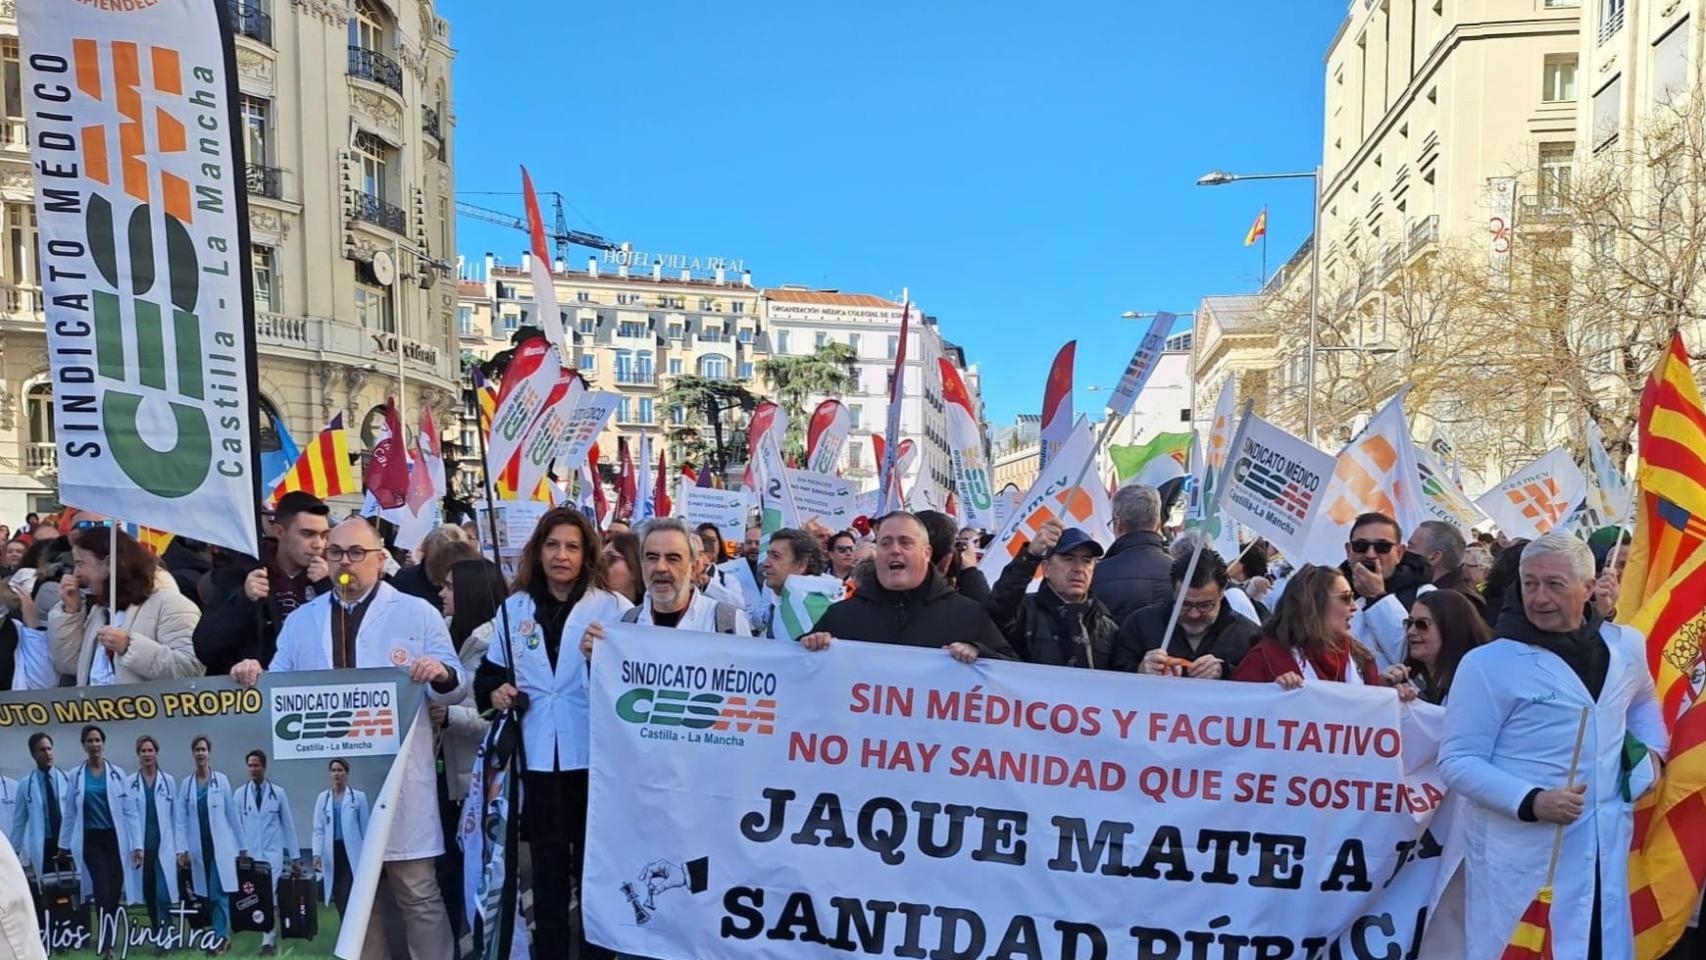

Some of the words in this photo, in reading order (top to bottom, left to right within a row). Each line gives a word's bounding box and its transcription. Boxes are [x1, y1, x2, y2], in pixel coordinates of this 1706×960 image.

[29, 53, 81, 213] MÉDICO
[188, 65, 224, 214] Mancha
[72, 38, 212, 499] CESM
[202, 236, 230, 277] La
[604, 249, 649, 267] HOTEL
[657, 253, 700, 270] VILLA
[708, 257, 746, 273] REAL
[47, 240, 102, 458] SINDICATO
[209, 331, 244, 479] Castilla
[1243, 436, 1285, 473] SINDICATO
[1285, 460, 1320, 492] MÉDICO
[275, 692, 339, 712] SINDICATO
[343, 688, 390, 709] MÉDICO
[621, 660, 707, 689] SINDICATO
[711, 664, 777, 696] MÉDICO
[0, 703, 49, 726] UTO
[52, 695, 157, 723] MARCO
[161, 688, 262, 717] PROPIO
[275, 709, 393, 741] CESM
[615, 688, 777, 735] CESM
[850, 682, 914, 717] SIN
[927, 685, 1101, 736] MÉDICOS
[1111, 708, 1137, 739] Y
[1148, 712, 1401, 758] FACULTATIVO
[296, 744, 323, 752] Castilla
[331, 743, 340, 751] La
[342, 741, 372, 750] Mancha
[640, 727, 678, 741] Castilla
[688, 731, 701, 742] La
[704, 733, 744, 747] Mancha
[788, 731, 848, 765] NO
[860, 738, 942, 773] HAY
[949, 746, 1126, 791] SANIDAD
[1139, 765, 1223, 803] QUE
[1234, 772, 1278, 804] SE
[1285, 776, 1443, 814] SOSTENGA
[740, 788, 1028, 866] JAQUE
[1047, 815, 1307, 890] MATE
[1320, 838, 1373, 892] A
[40, 909, 91, 957] diós
[97, 900, 224, 959] Ministra
[721, 886, 1108, 960] SANIDAD
